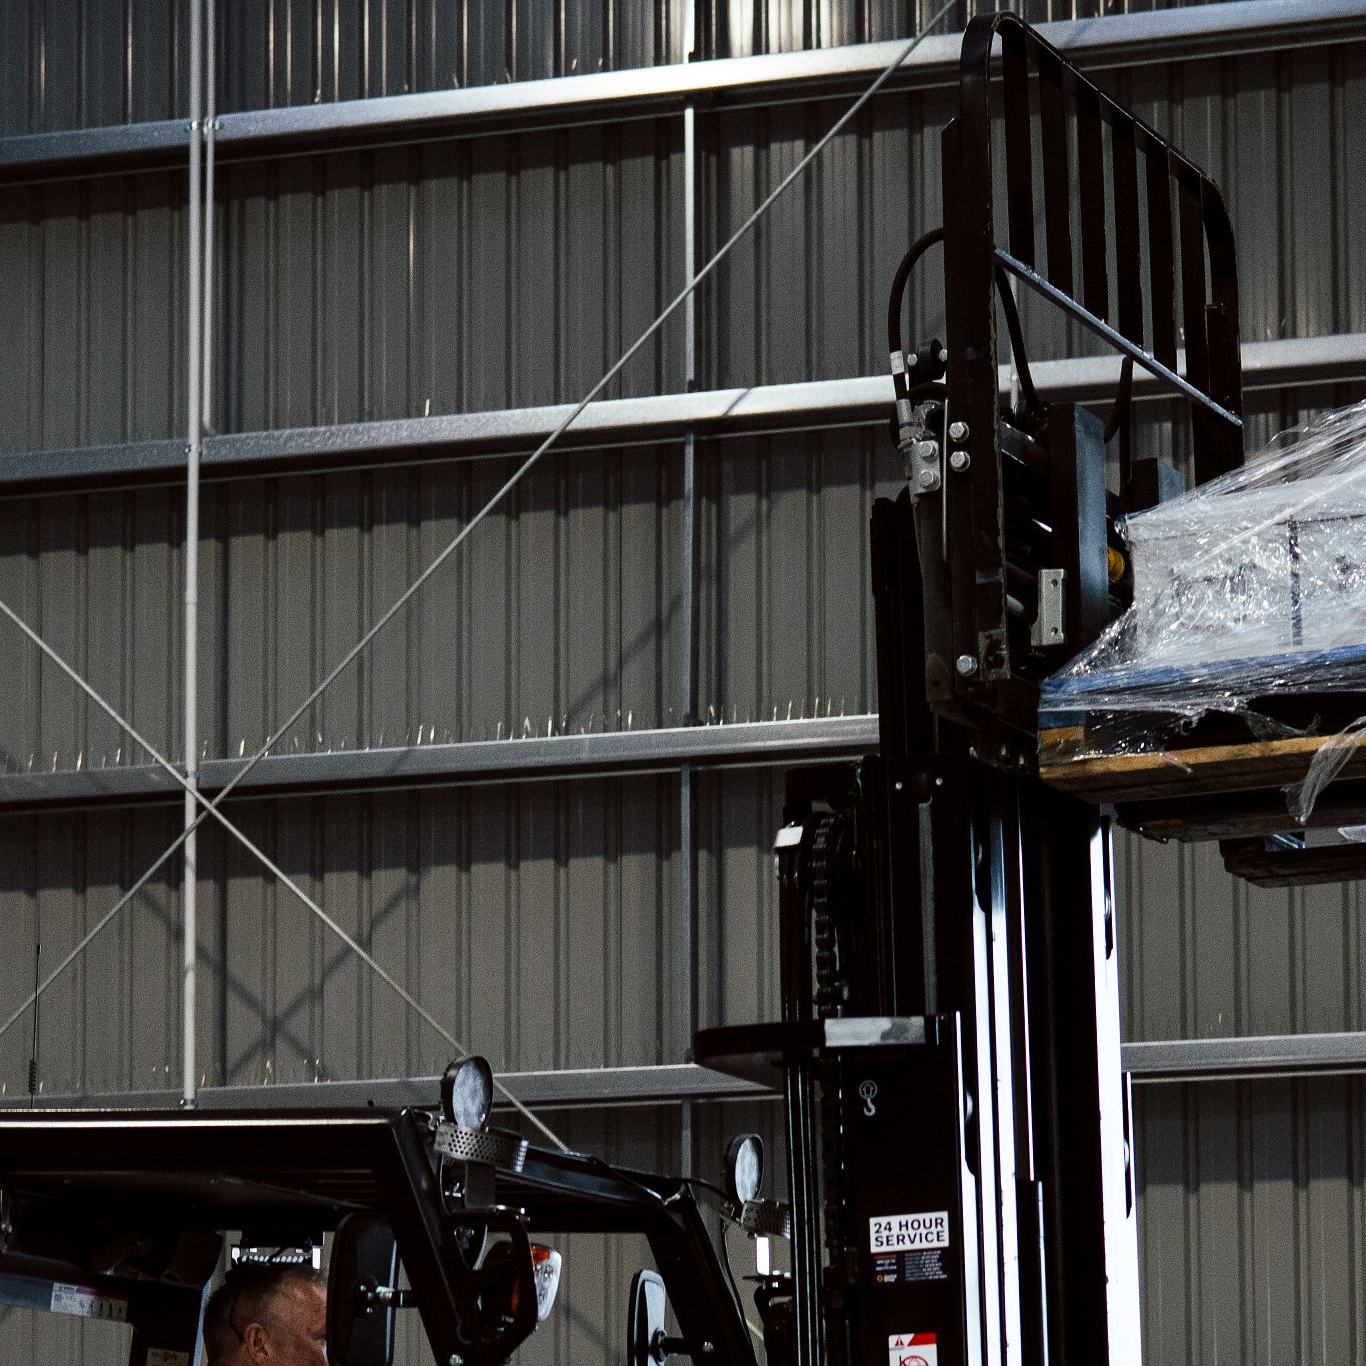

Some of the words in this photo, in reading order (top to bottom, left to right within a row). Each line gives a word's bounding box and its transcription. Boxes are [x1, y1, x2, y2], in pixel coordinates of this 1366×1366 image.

[874, 1221, 892, 1234] 24
[898, 1217, 944, 1232] HOUR
[874, 1230, 945, 1247] SERVICE
